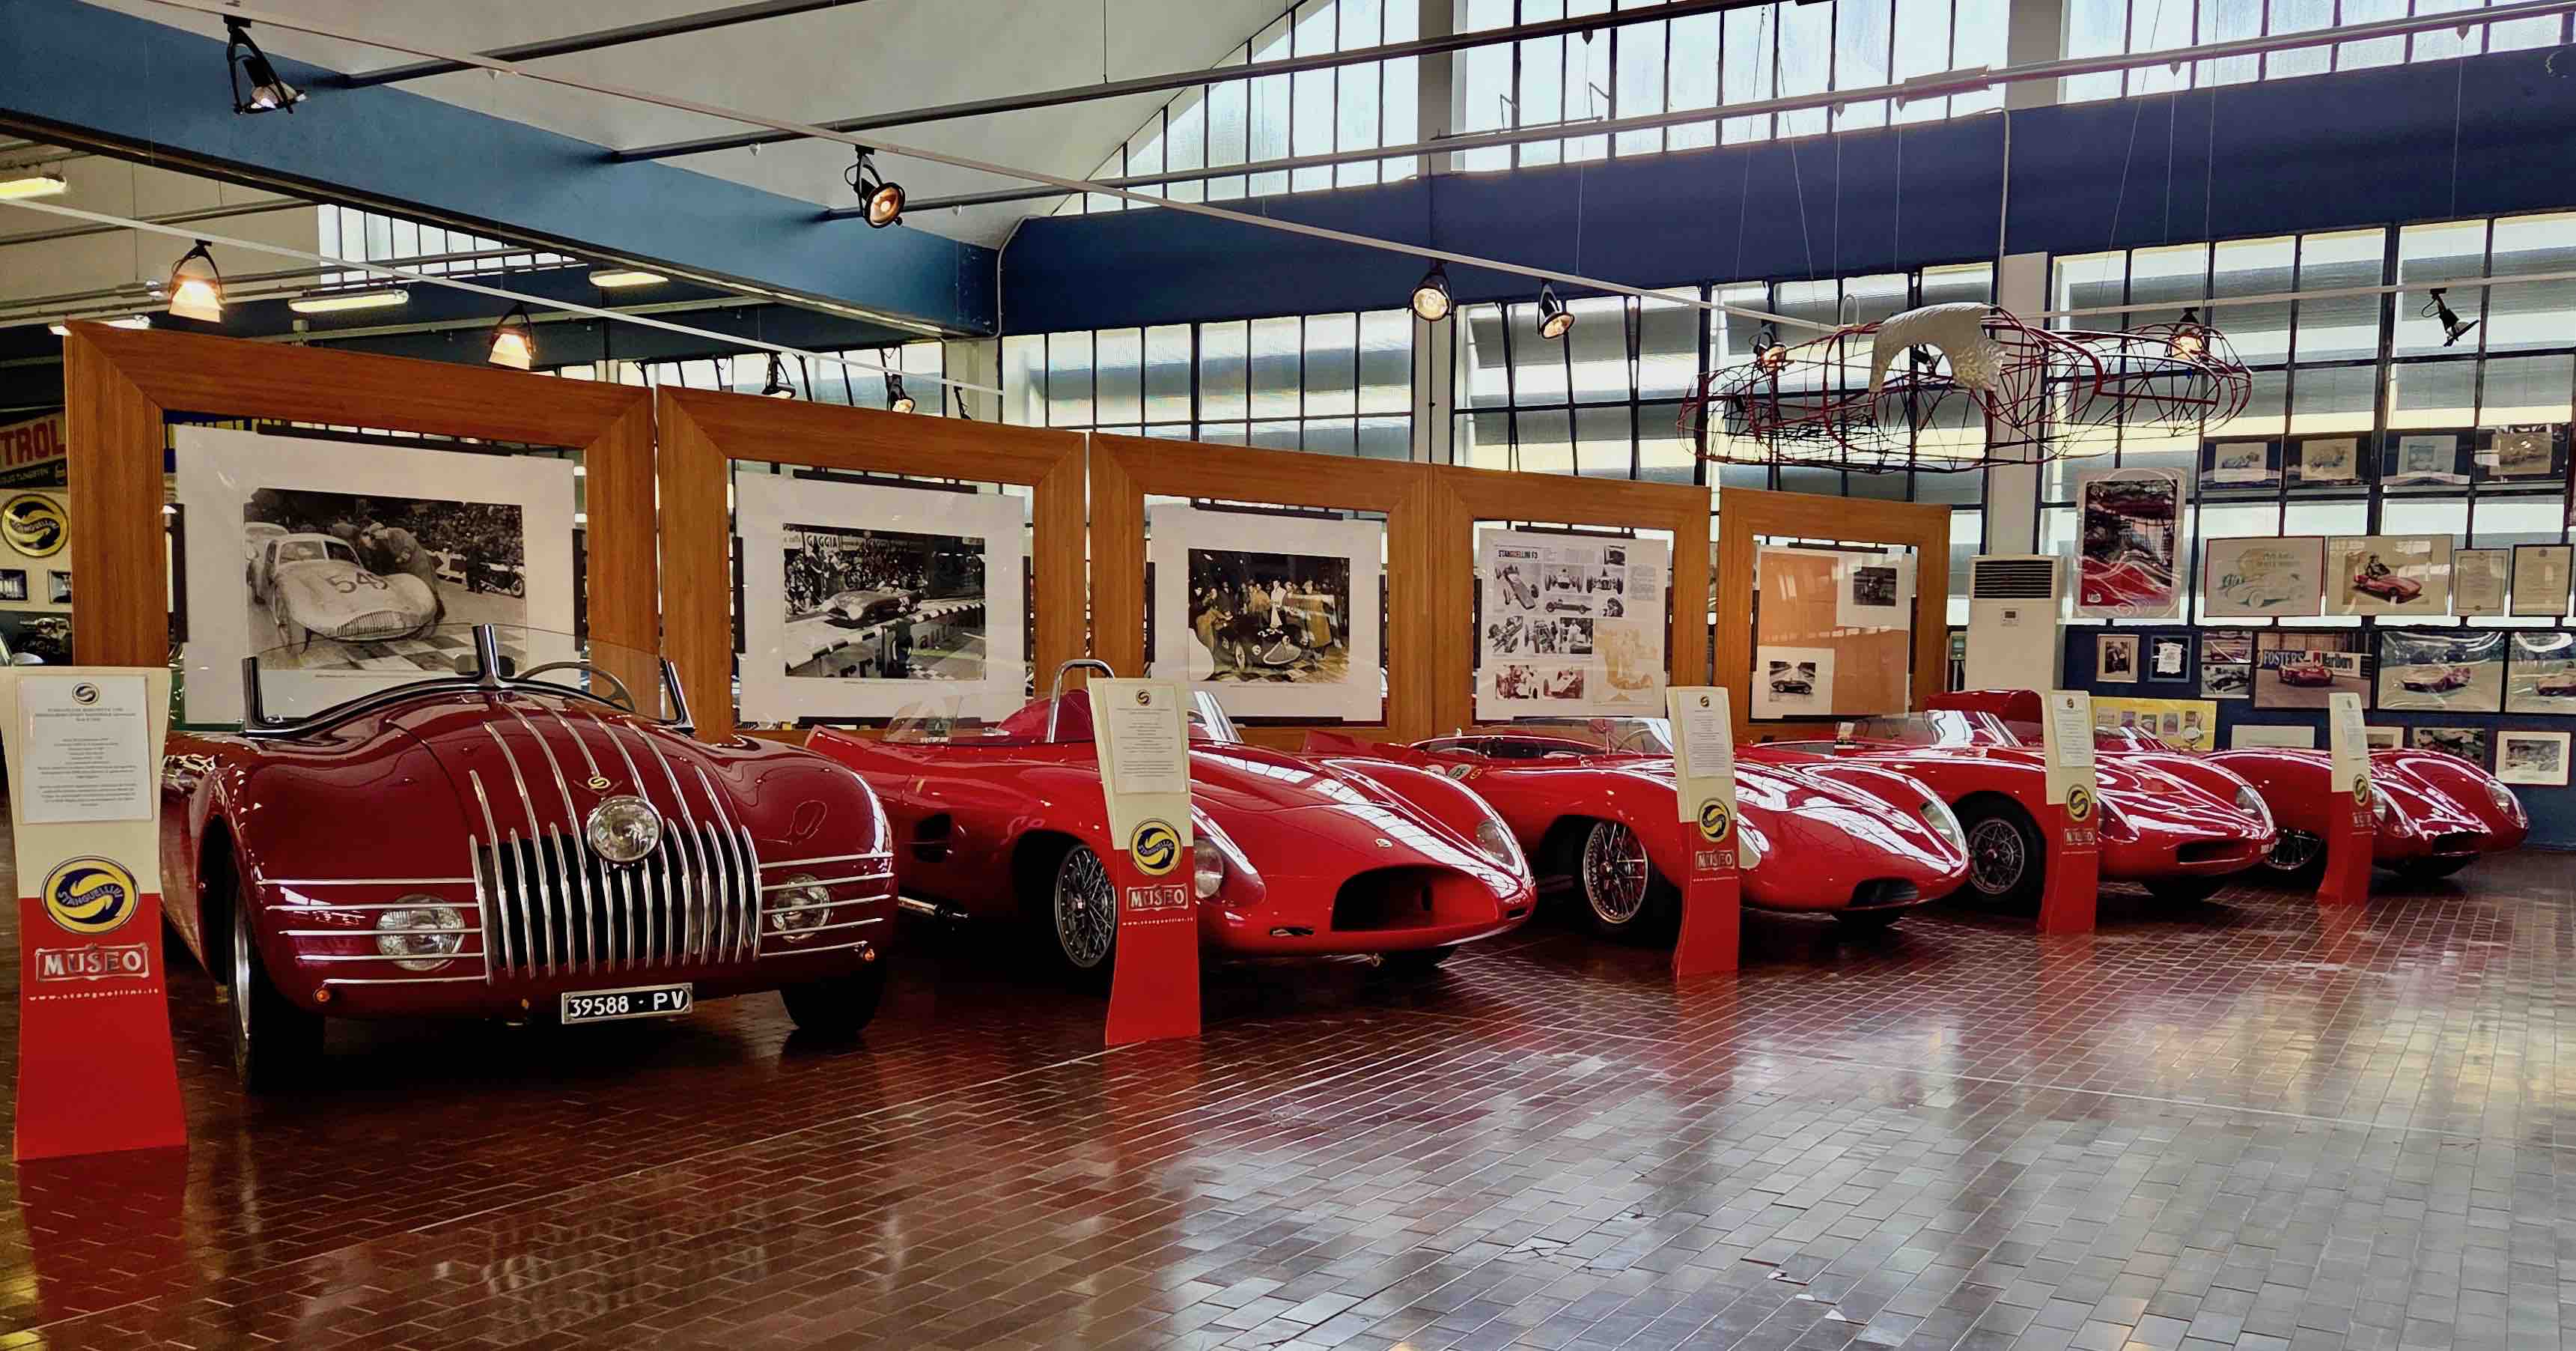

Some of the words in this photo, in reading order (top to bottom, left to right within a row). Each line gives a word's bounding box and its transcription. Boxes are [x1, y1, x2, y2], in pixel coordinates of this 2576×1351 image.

[807, 534, 838, 548] GAGGIA
[58, 884, 124, 906] STANGUELLINI
[1130, 888, 1185, 908] MUSEO
[43, 950, 142, 977] MUSEO
[28, 988, 159, 1001] www.stanguellini.it
[570, 995, 629, 1017] 39588
